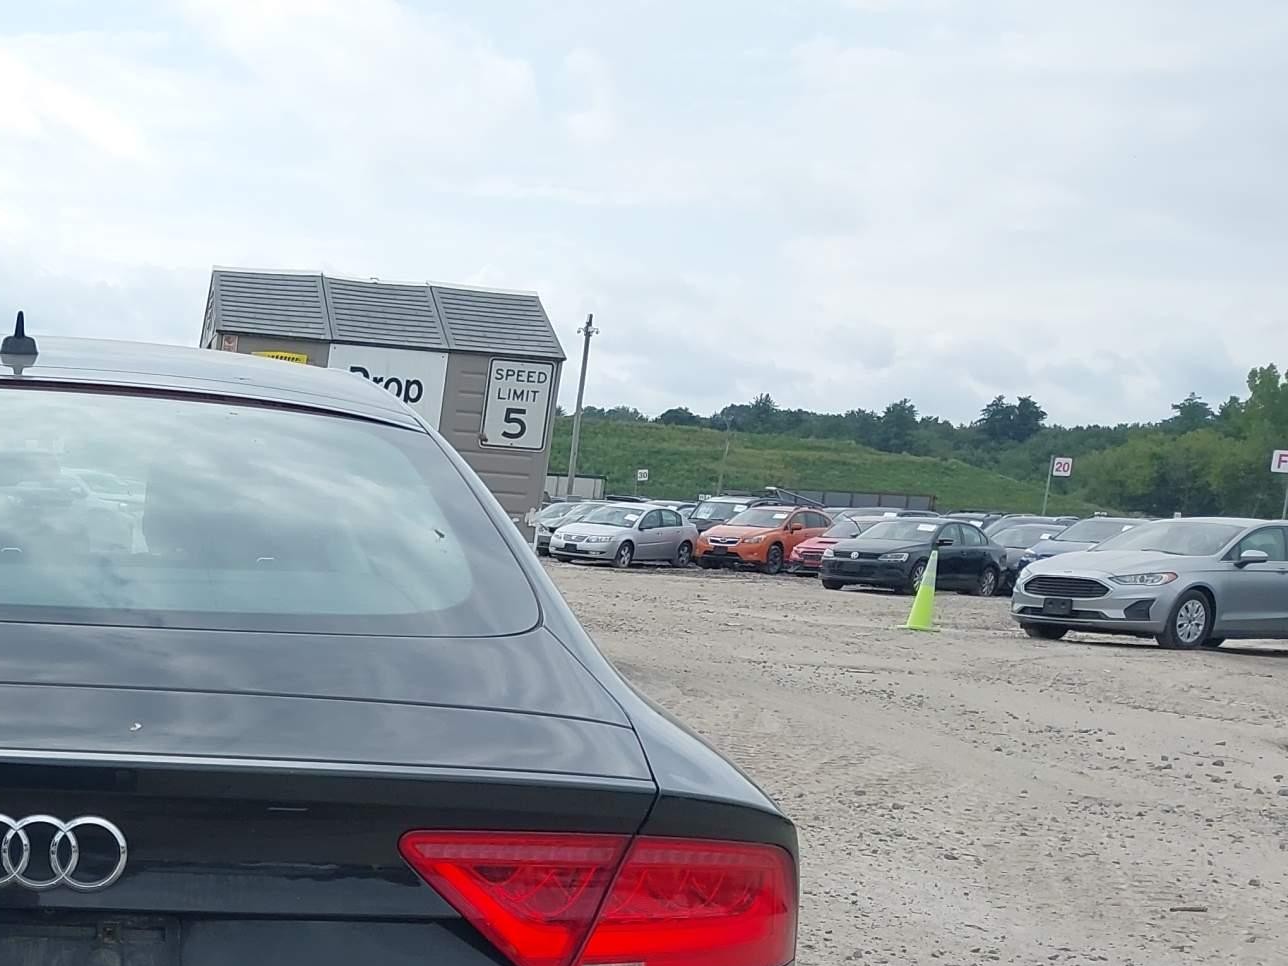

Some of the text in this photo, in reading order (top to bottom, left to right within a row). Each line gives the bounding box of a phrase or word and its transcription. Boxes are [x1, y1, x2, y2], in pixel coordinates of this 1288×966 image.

[494, 368, 548, 384] SPEED
[497, 387, 540, 403] LIMIT
[501, 407, 527, 440] 5
[1056, 462, 1070, 472] 20
